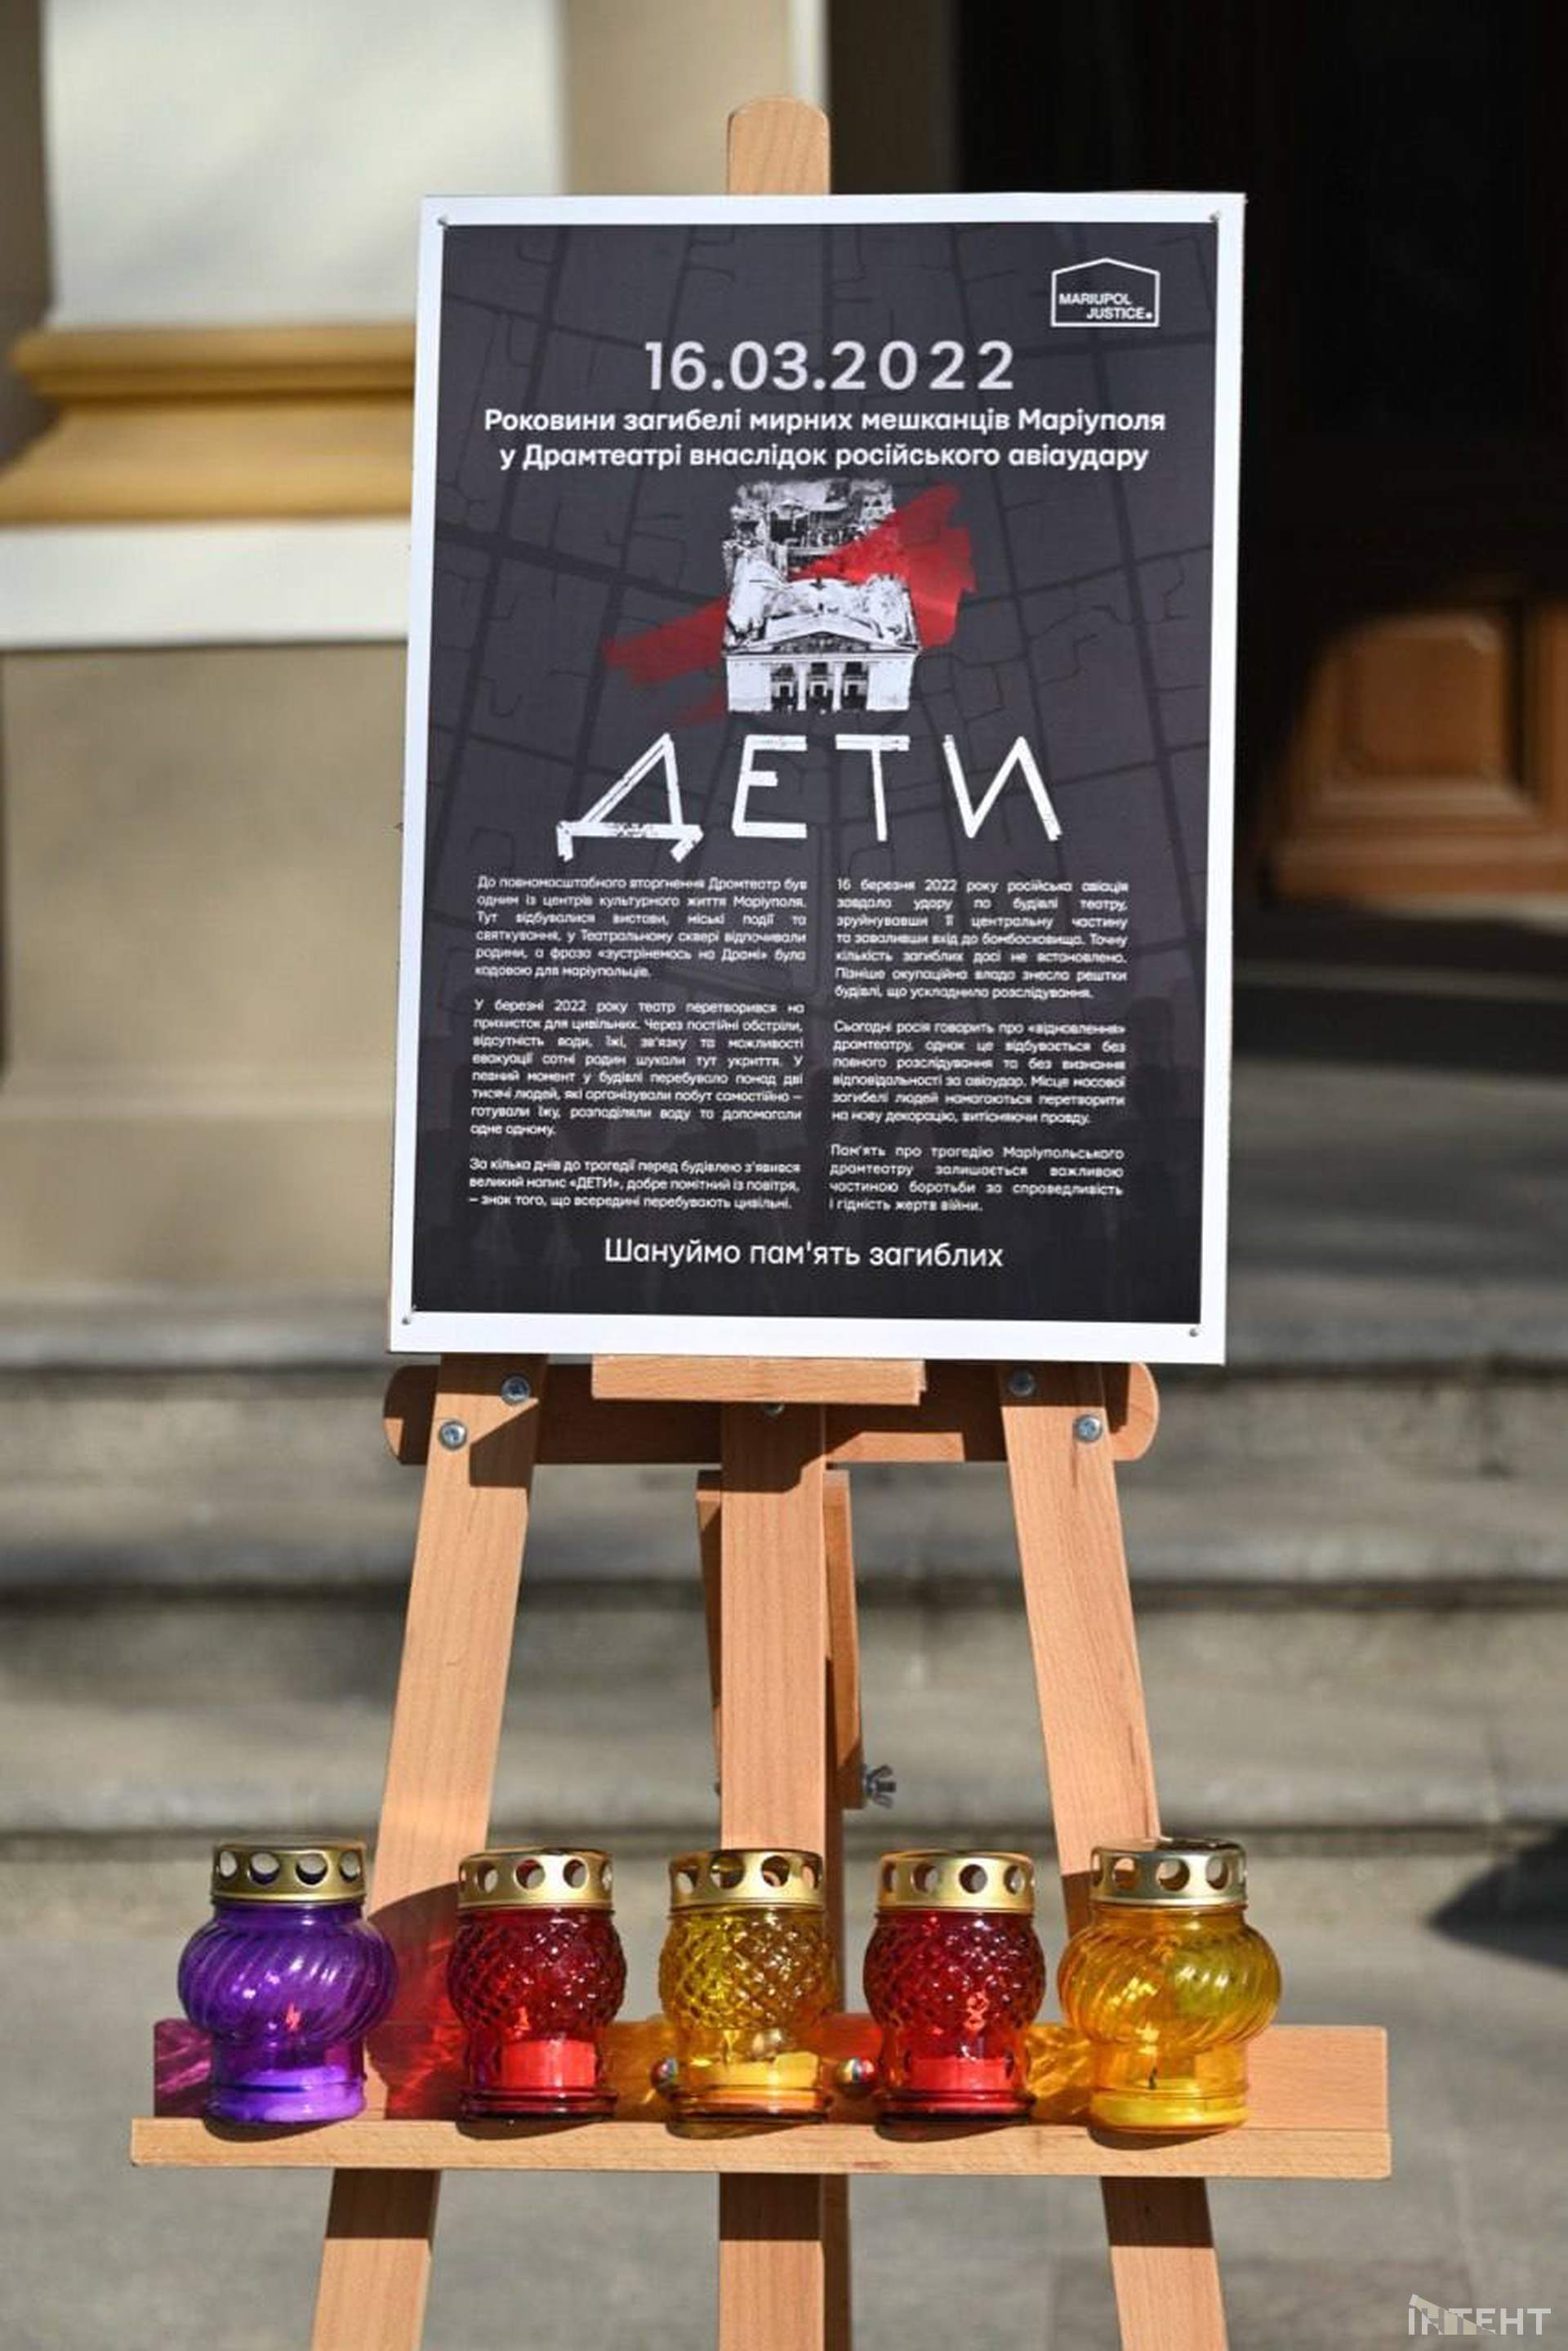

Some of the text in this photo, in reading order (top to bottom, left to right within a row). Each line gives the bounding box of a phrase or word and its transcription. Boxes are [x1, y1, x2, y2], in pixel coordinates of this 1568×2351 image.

[1058, 293, 1132, 306] MARIUPOL
[646, 340, 1013, 391] 16.03.2022
[484, 408, 1165, 435] Роковини загибелі мирних мешканців Маріуполя
[500, 444, 1149, 471] у Драмтеатрі внаслідок російського авіаудару
[556, 733, 1062, 863] ДЕТИ
[604, 1238, 1004, 1268] Шануймо пам'ять загиблих
